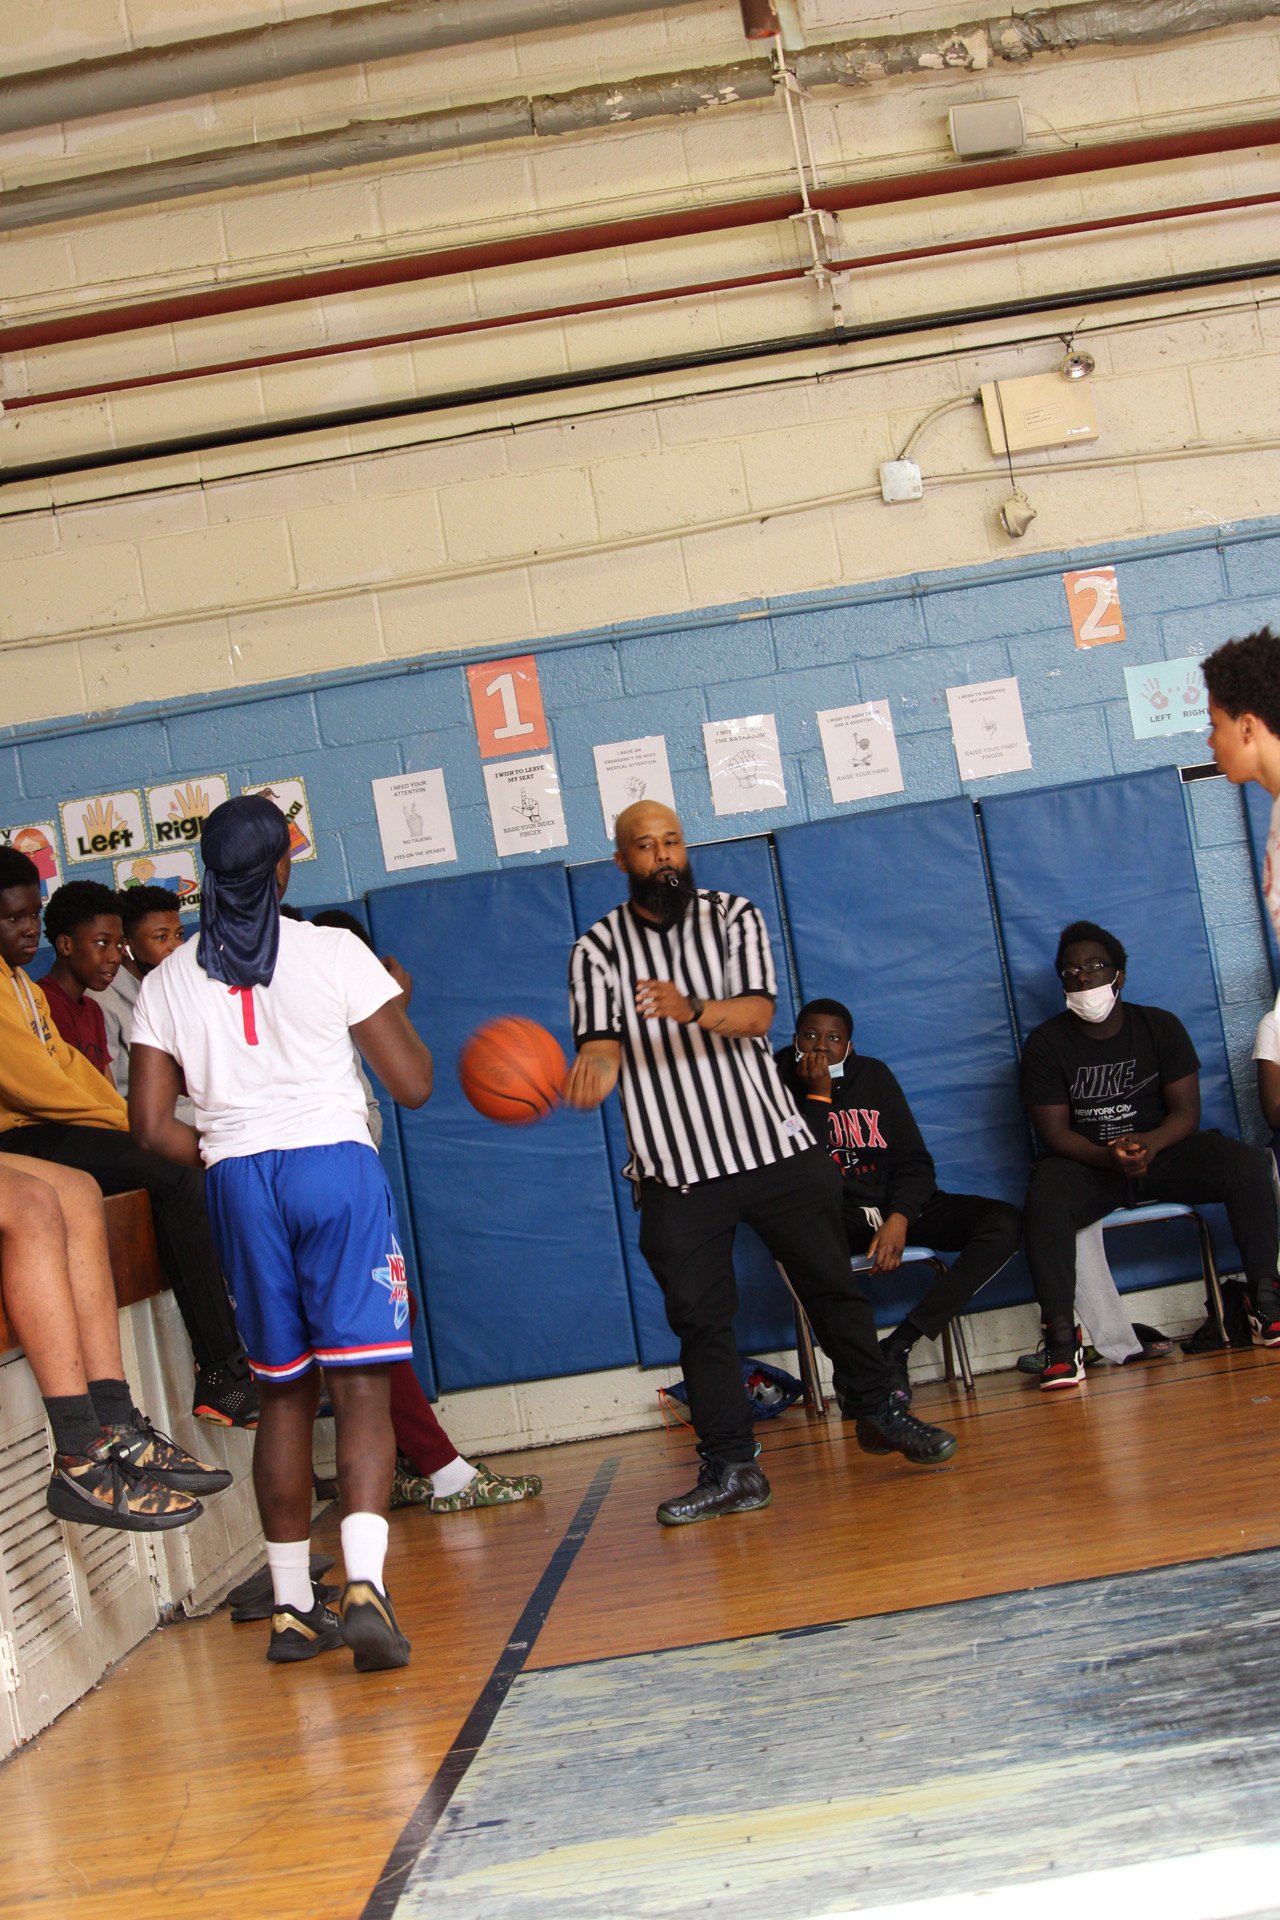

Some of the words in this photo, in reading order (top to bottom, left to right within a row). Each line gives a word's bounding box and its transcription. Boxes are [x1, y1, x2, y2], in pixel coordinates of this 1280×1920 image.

[1074, 575, 1120, 641] 2
[486, 673, 535, 740] 1
[1150, 713, 1172, 723] LEFT
[498, 770, 515, 778] WISH
[525, 765, 545, 773] LEAVE
[855, 770, 872, 778] YOUR
[393, 783, 409, 791] NEED
[394, 787, 426, 797] ATTENTION
[155, 816, 204, 842] Rig
[520, 823, 537, 831] YOUR
[76, 829, 134, 855] Left
[1072, 1059, 1136, 1099] NIKE
[1075, 1108, 1092, 1116] NEW
[1092, 1106, 1115, 1116] YORK
[1116, 1104, 1131, 1113] City
[828, 1108, 888, 1149] ONX
[388, 1255, 407, 1282] NB
